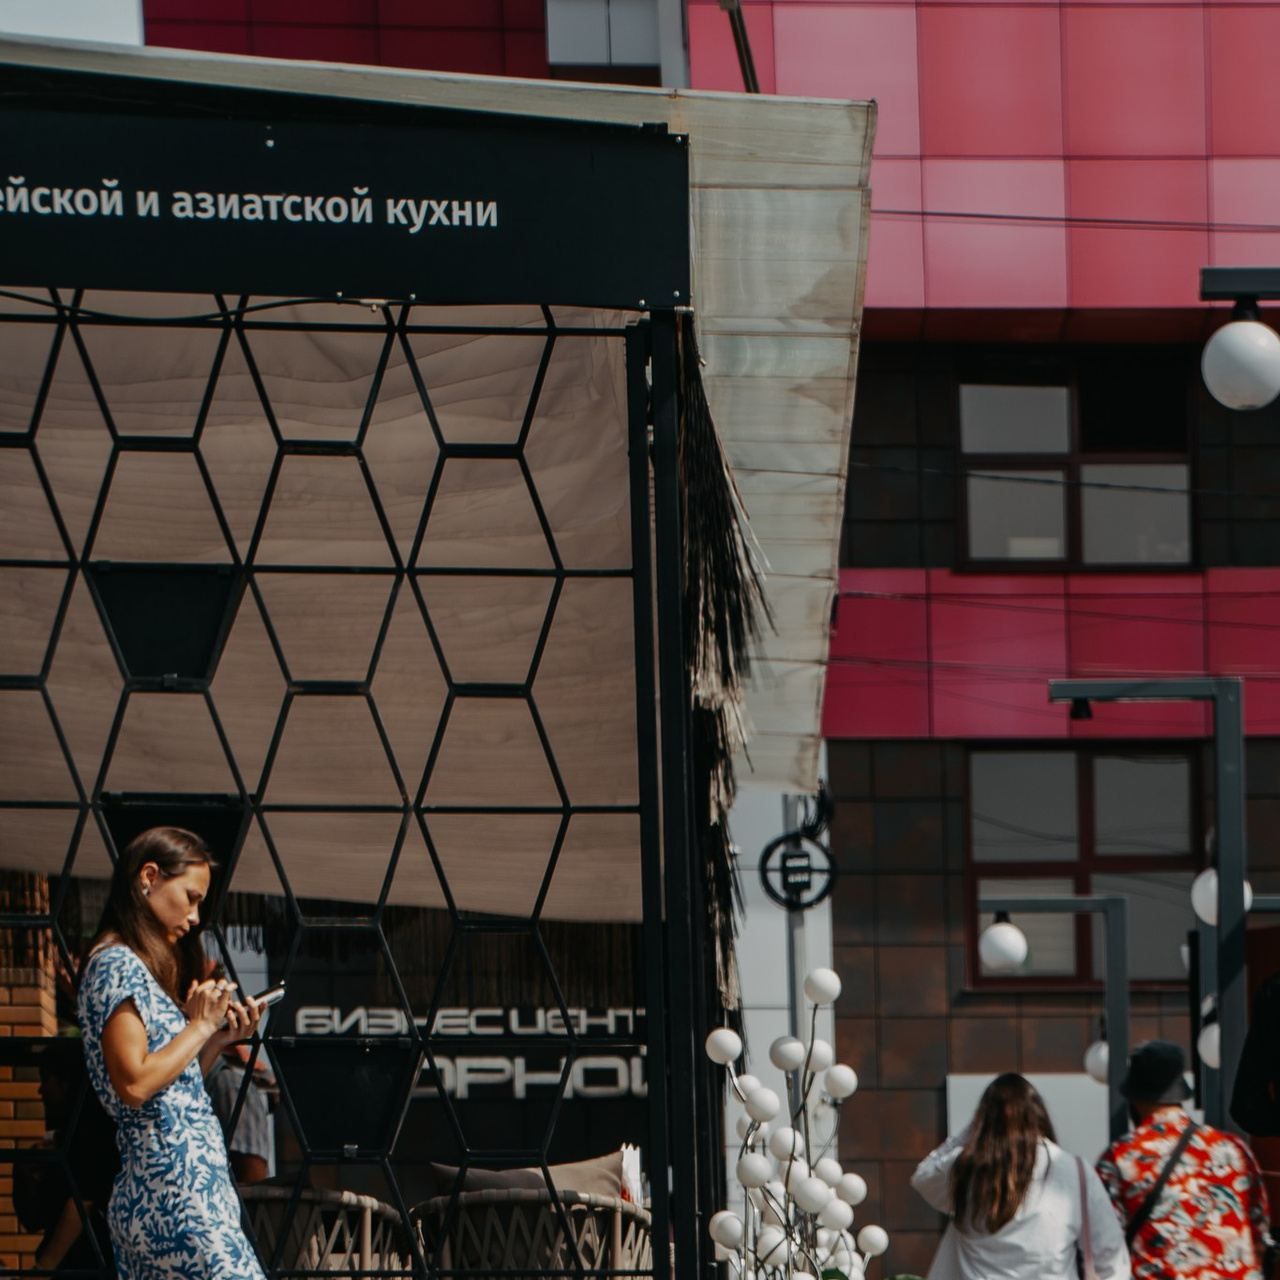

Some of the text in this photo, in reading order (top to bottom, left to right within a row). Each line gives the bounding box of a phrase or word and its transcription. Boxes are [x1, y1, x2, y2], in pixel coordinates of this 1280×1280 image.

[0, 175, 498, 234] йской и азиатской кухни
[295, 1005, 504, 1036] БИЗНЕС
